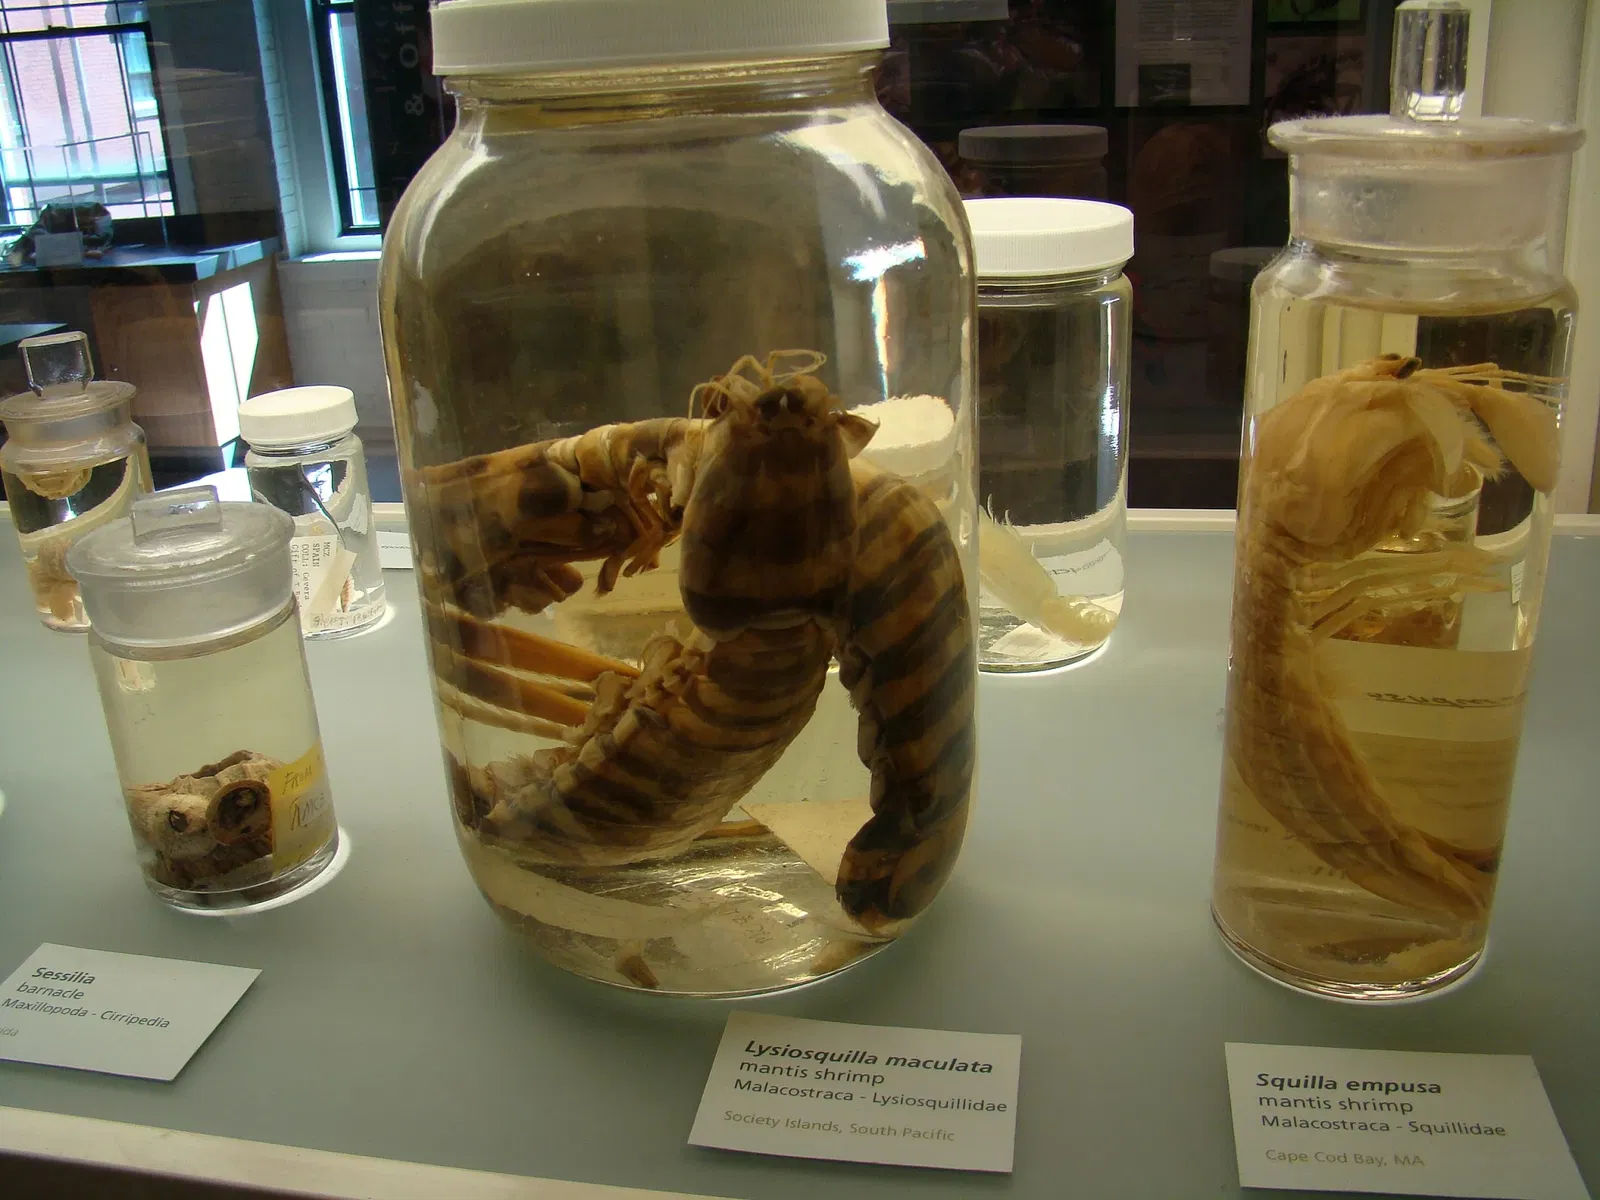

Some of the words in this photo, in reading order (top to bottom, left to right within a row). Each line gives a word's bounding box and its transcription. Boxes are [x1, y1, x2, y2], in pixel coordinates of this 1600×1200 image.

[312, 543, 320, 567] SPAIN
[31, 967, 96, 985] Sessilia
[16, 981, 85, 1000] barnacle
[1, 998, 88, 1017] Maxillopoda
[100, 1010, 170, 1029] Cirripedia
[0, 1026, 19, 1037] ida
[744, 1040, 878, 1066] Lysiosquilla
[885, 1055, 993, 1074] maculata
[739, 1061, 808, 1079] mantis
[814, 1068, 885, 1086] shrimp
[1256, 1073, 1337, 1092] Squilla
[1345, 1080, 1442, 1096] empusa
[733, 1078, 854, 1101] Malacostraca
[872, 1092, 1007, 1112] Lysiosquillidae
[1258, 1095, 1332, 1111] mantis
[1338, 1098, 1413, 1114] shrimp
[723, 1110, 780, 1128] Society
[785, 1117, 843, 1134] Islands,
[849, 1123, 897, 1138] South
[903, 1127, 955, 1141] Pacific
[1261, 1115, 1390, 1133] Malacostraca
[1408, 1120, 1506, 1138] Squillidae
[1265, 1148, 1309, 1163] Cape
[1314, 1151, 1348, 1164] Cod
[1353, 1154, 1387, 1168] Bay,
[1394, 1155, 1425, 1168] MA
